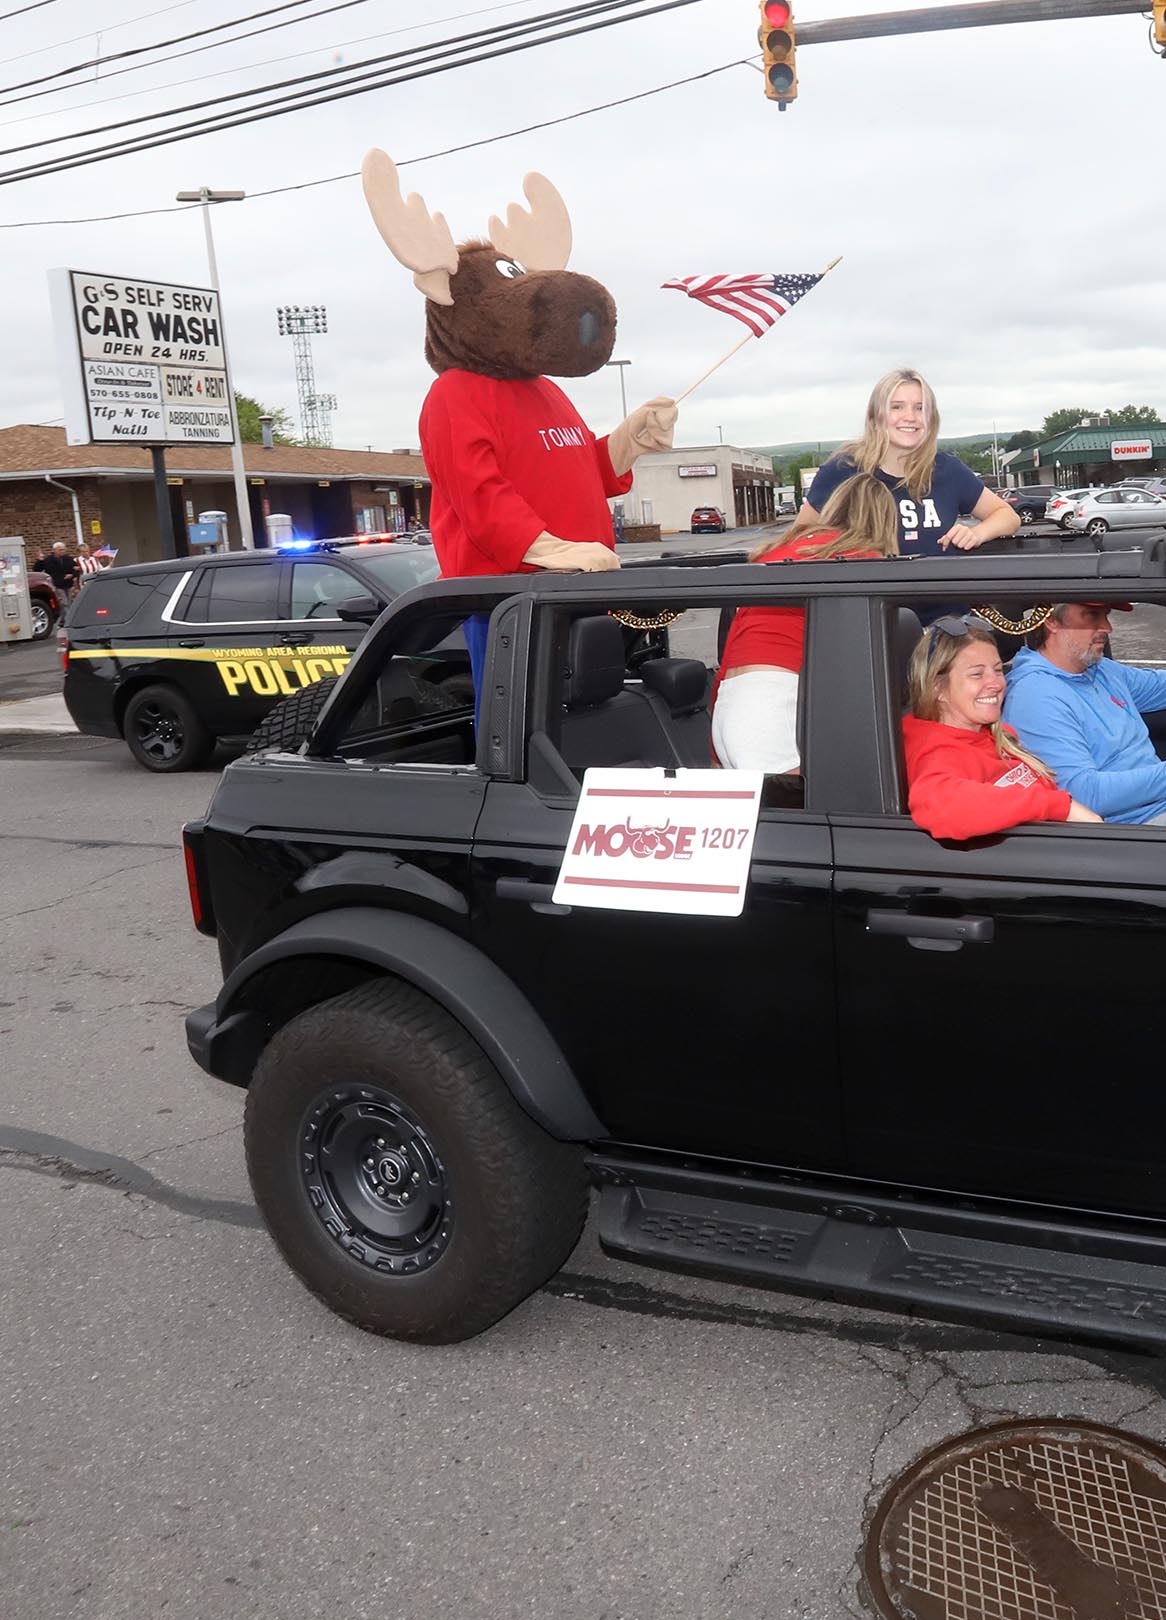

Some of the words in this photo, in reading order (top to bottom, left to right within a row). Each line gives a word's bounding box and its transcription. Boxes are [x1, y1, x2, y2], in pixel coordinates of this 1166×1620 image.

[125, 286, 165, 307] SELF
[172, 292, 213, 313] SERV
[82, 304, 140, 339] CAR
[147, 311, 219, 346] WASH
[103, 342, 143, 357] OPEN
[151, 346, 172, 358] 24
[179, 349, 209, 362] HRS.
[88, 365, 125, 377] ASIAN
[128, 367, 156, 379] CAFE
[166, 374, 194, 397] STORE
[196, 380, 203, 394] 4
[204, 376, 226, 398] RENT
[90, 389, 159, 400] 570-655-0808
[169, 411, 230, 426] ABBRONZATURA
[112, 425, 148, 435] Nails
[182, 428, 220, 438] TANNING
[538, 427, 587, 451] TOMMY
[1114, 446, 1150, 454] DUNKIN'
[212, 648, 263, 658] WYOMING
[267, 647, 295, 657] AREA
[297, 645, 349, 656] REGIONAL
[572, 824, 696, 859] MOOSE
[701, 828, 749, 849] 1207
